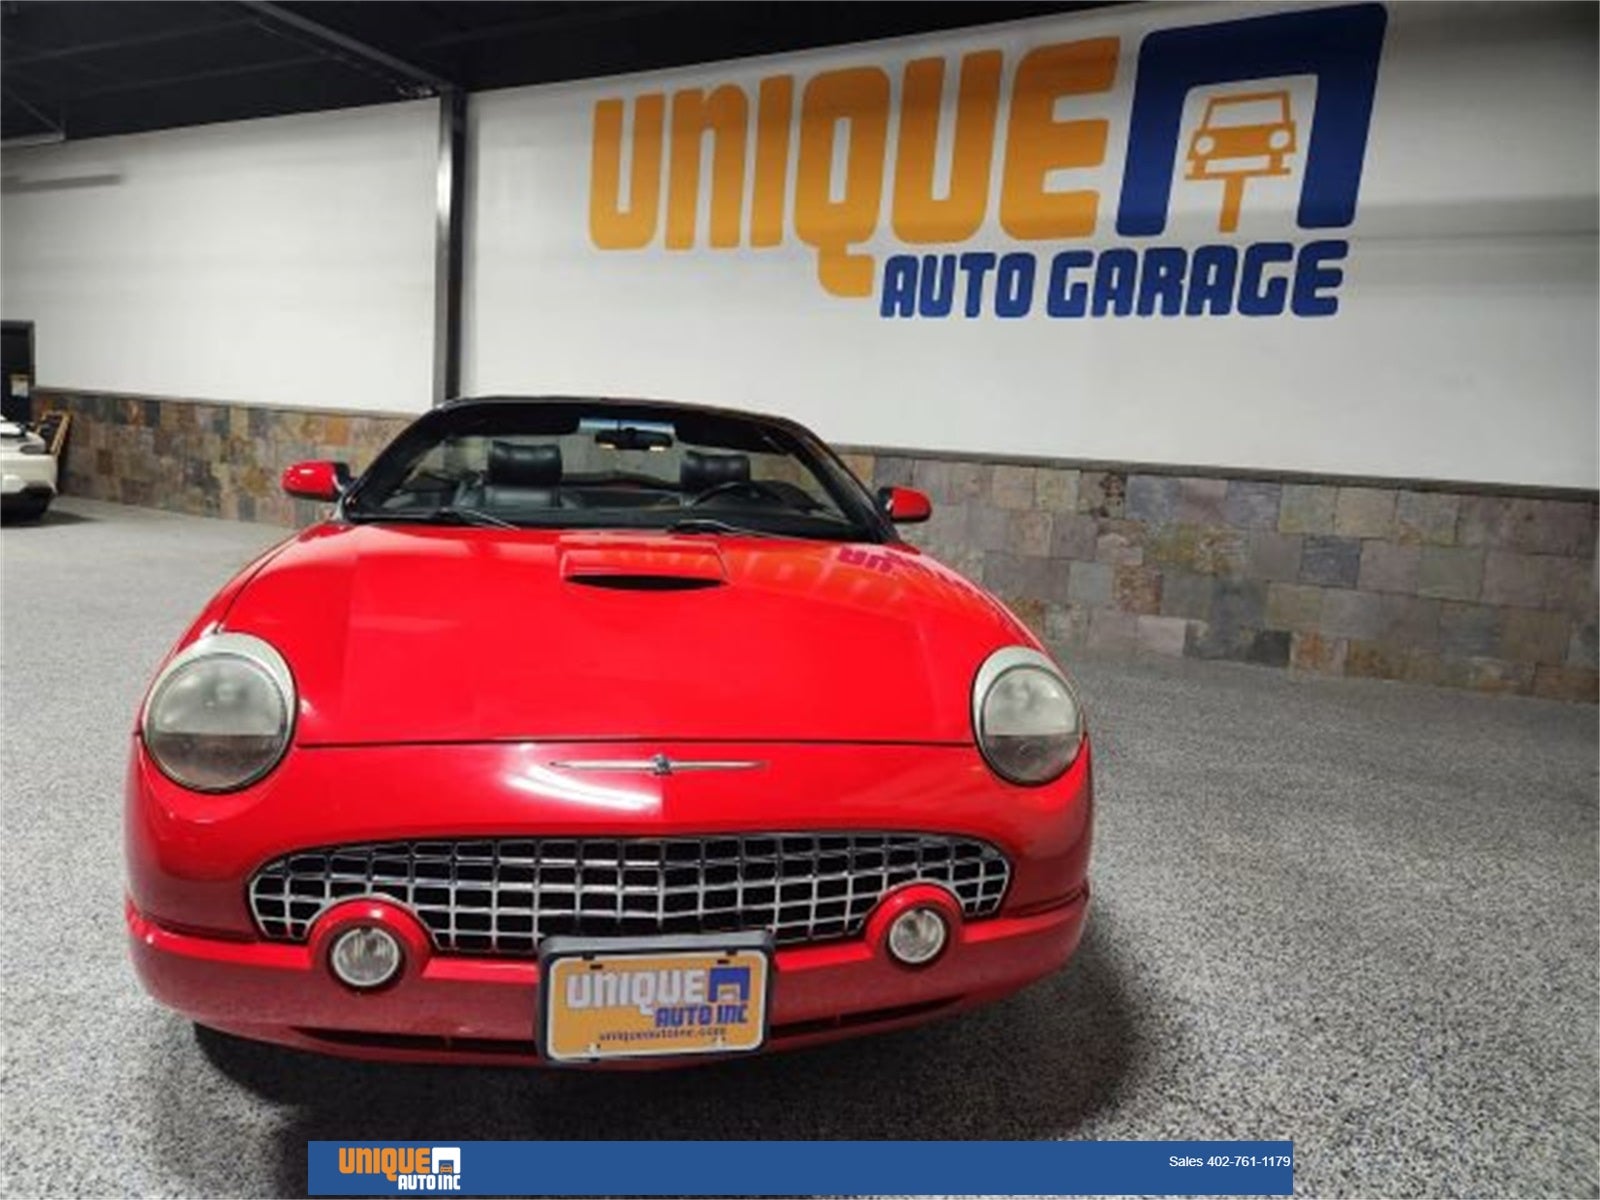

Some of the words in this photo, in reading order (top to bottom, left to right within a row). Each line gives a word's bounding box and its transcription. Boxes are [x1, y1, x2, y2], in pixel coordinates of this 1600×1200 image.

[589, 36, 1120, 297] UNIQUE
[880, 251, 1036, 318] AUTO
[1046, 240, 1348, 318] GARAGE
[567, 970, 704, 1015] UNIQUE
[655, 1005, 712, 1028] AUTO
[717, 1004, 748, 1024] INC
